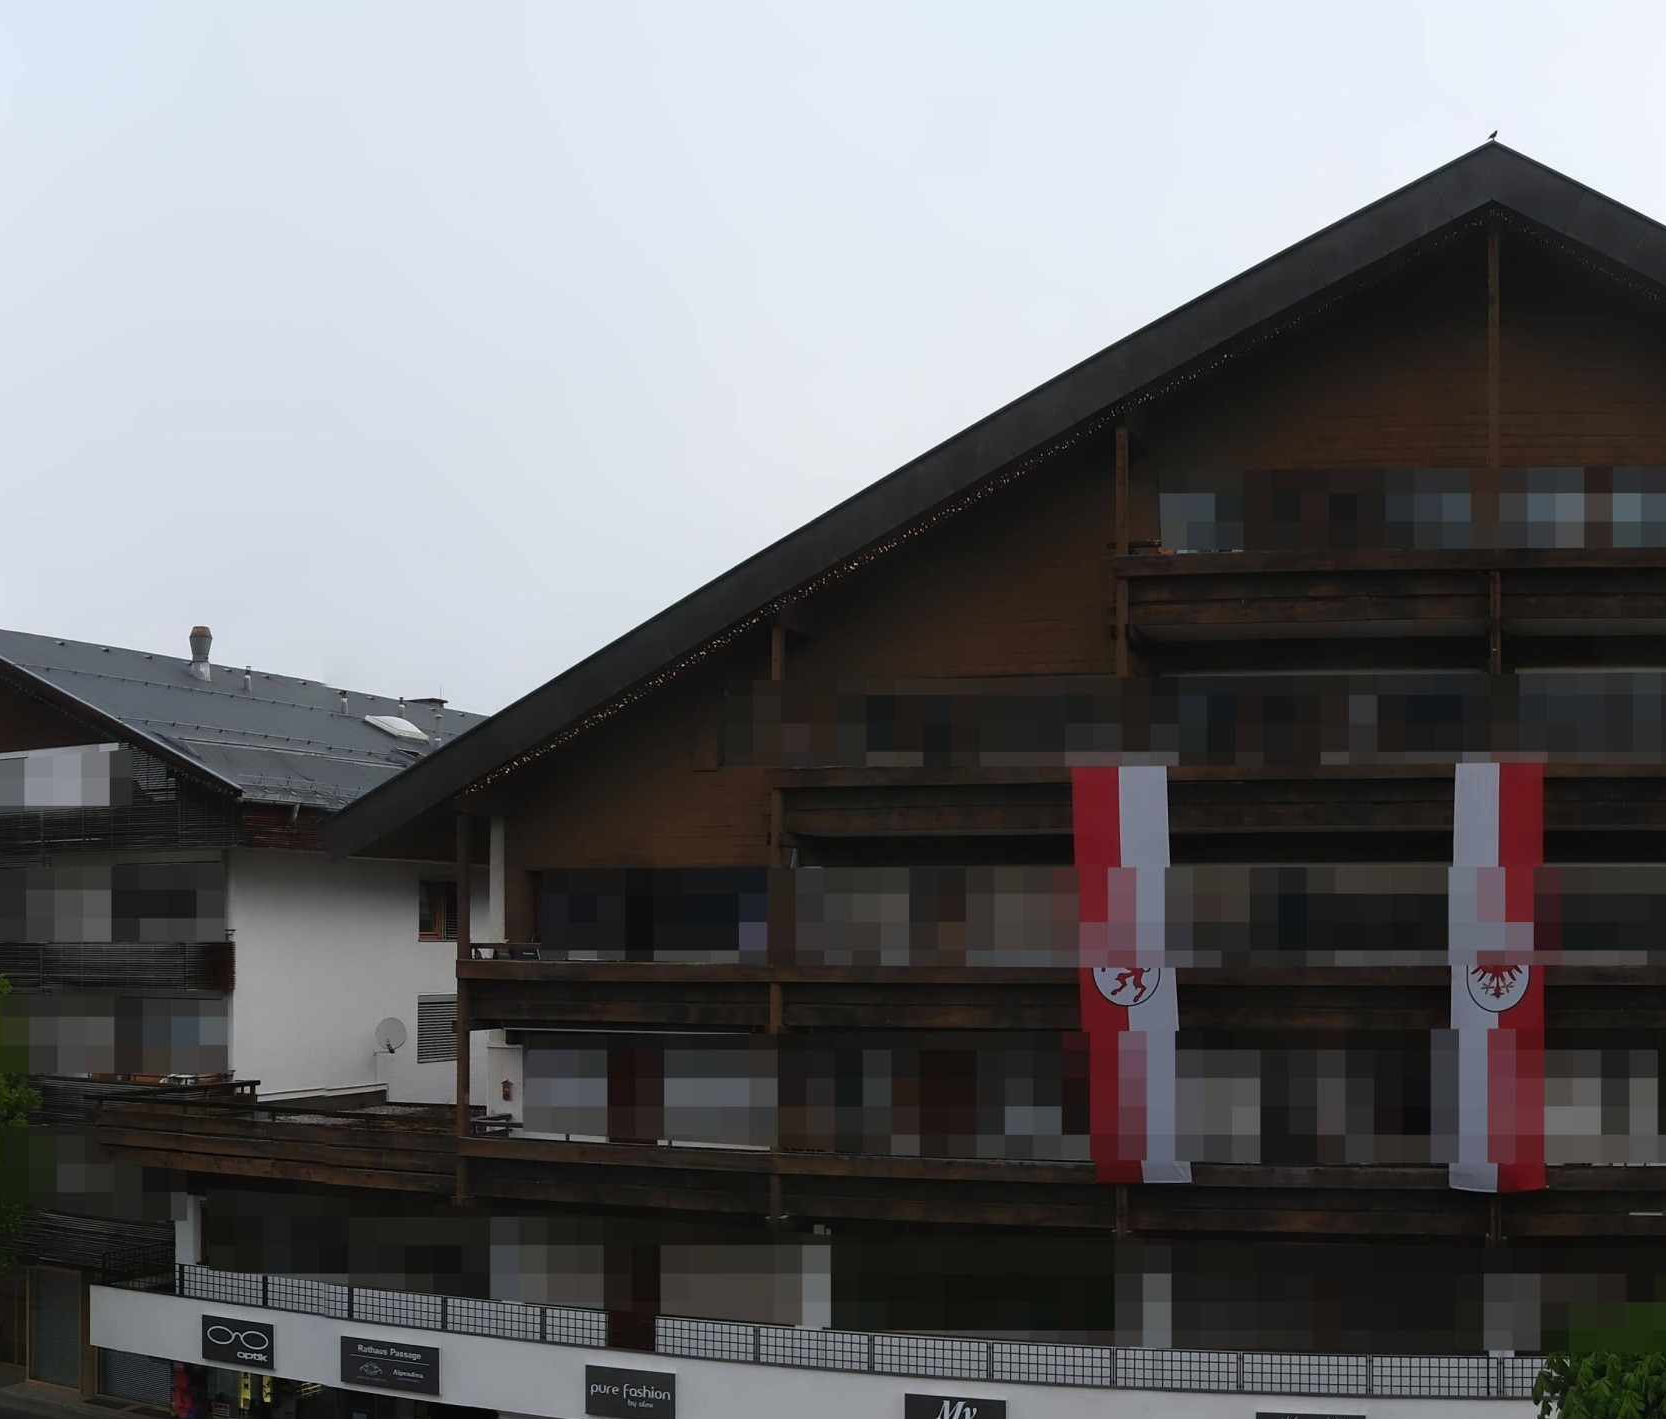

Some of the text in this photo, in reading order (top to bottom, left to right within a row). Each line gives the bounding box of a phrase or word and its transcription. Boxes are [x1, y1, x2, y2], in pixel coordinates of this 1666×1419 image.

[236, 1350, 269, 1363] optik
[357, 1343, 422, 1361] Rathaus Passage
[590, 1383, 671, 1401] pure fashion
[627, 1398, 637, 1409] by
